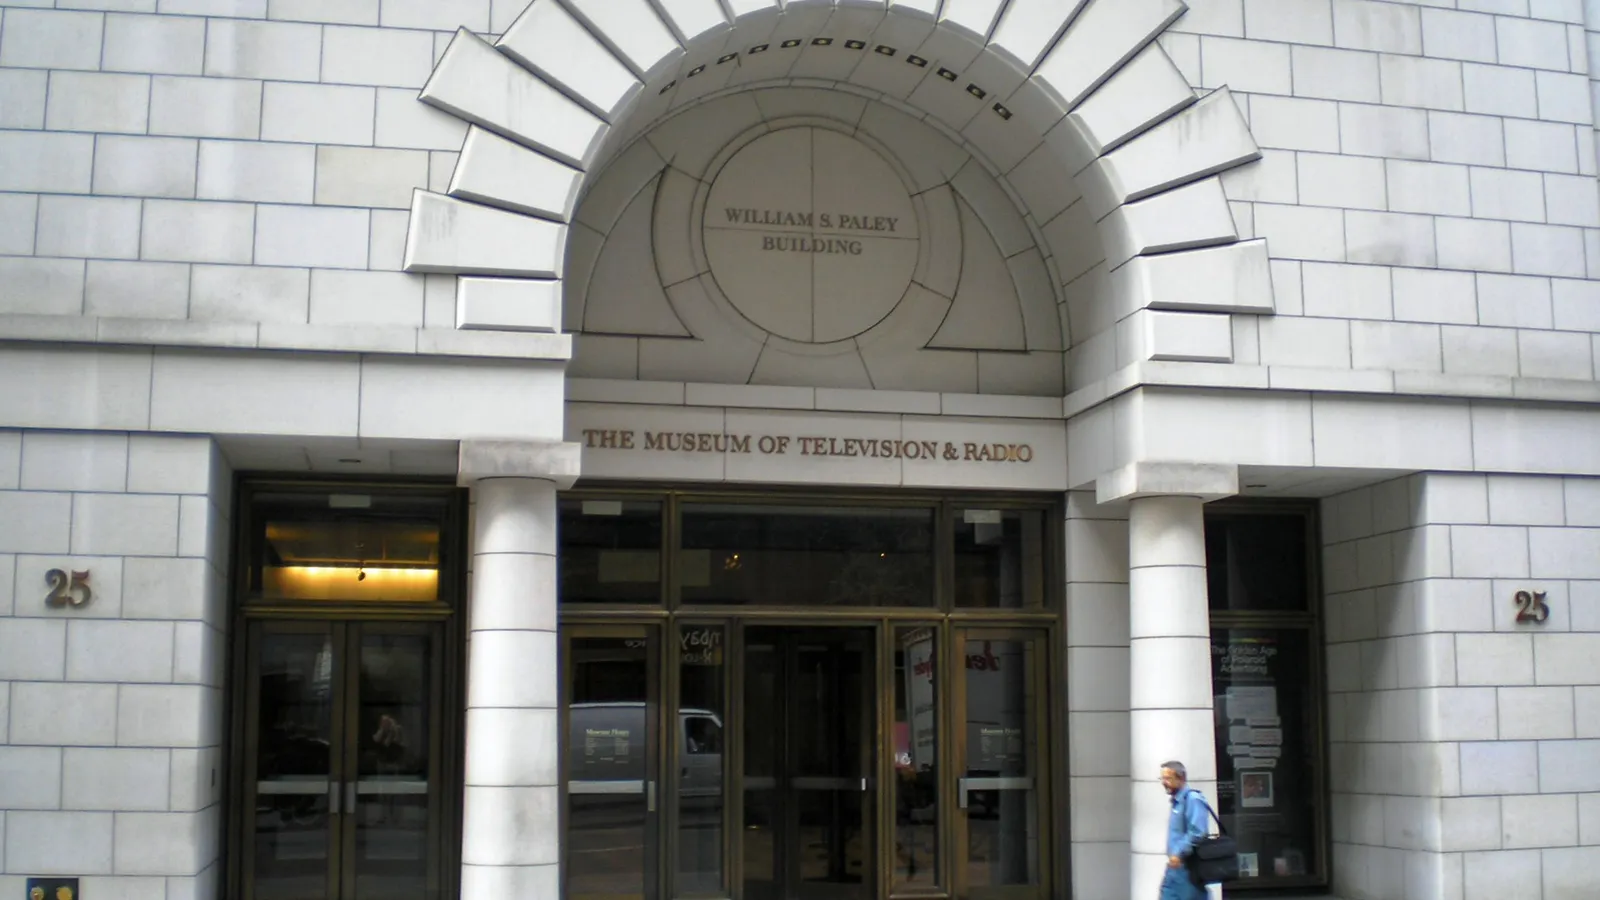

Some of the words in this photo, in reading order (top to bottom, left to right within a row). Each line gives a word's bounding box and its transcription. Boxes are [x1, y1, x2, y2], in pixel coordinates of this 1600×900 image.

[724, 207, 814, 228] WILLIAM
[819, 212, 834, 229] S.
[838, 213, 899, 233] PALEY
[761, 235, 863, 256] BUILDING
[582, 428, 635, 449] THE
[643, 431, 752, 454] MUSEUM
[757, 434, 791, 455] OF
[797, 436, 938, 460] TELEVISION
[942, 441, 959, 461] &
[963, 442, 1033, 463] RADIO
[45, 567, 92, 610] 25
[1514, 590, 1550, 626] 25
